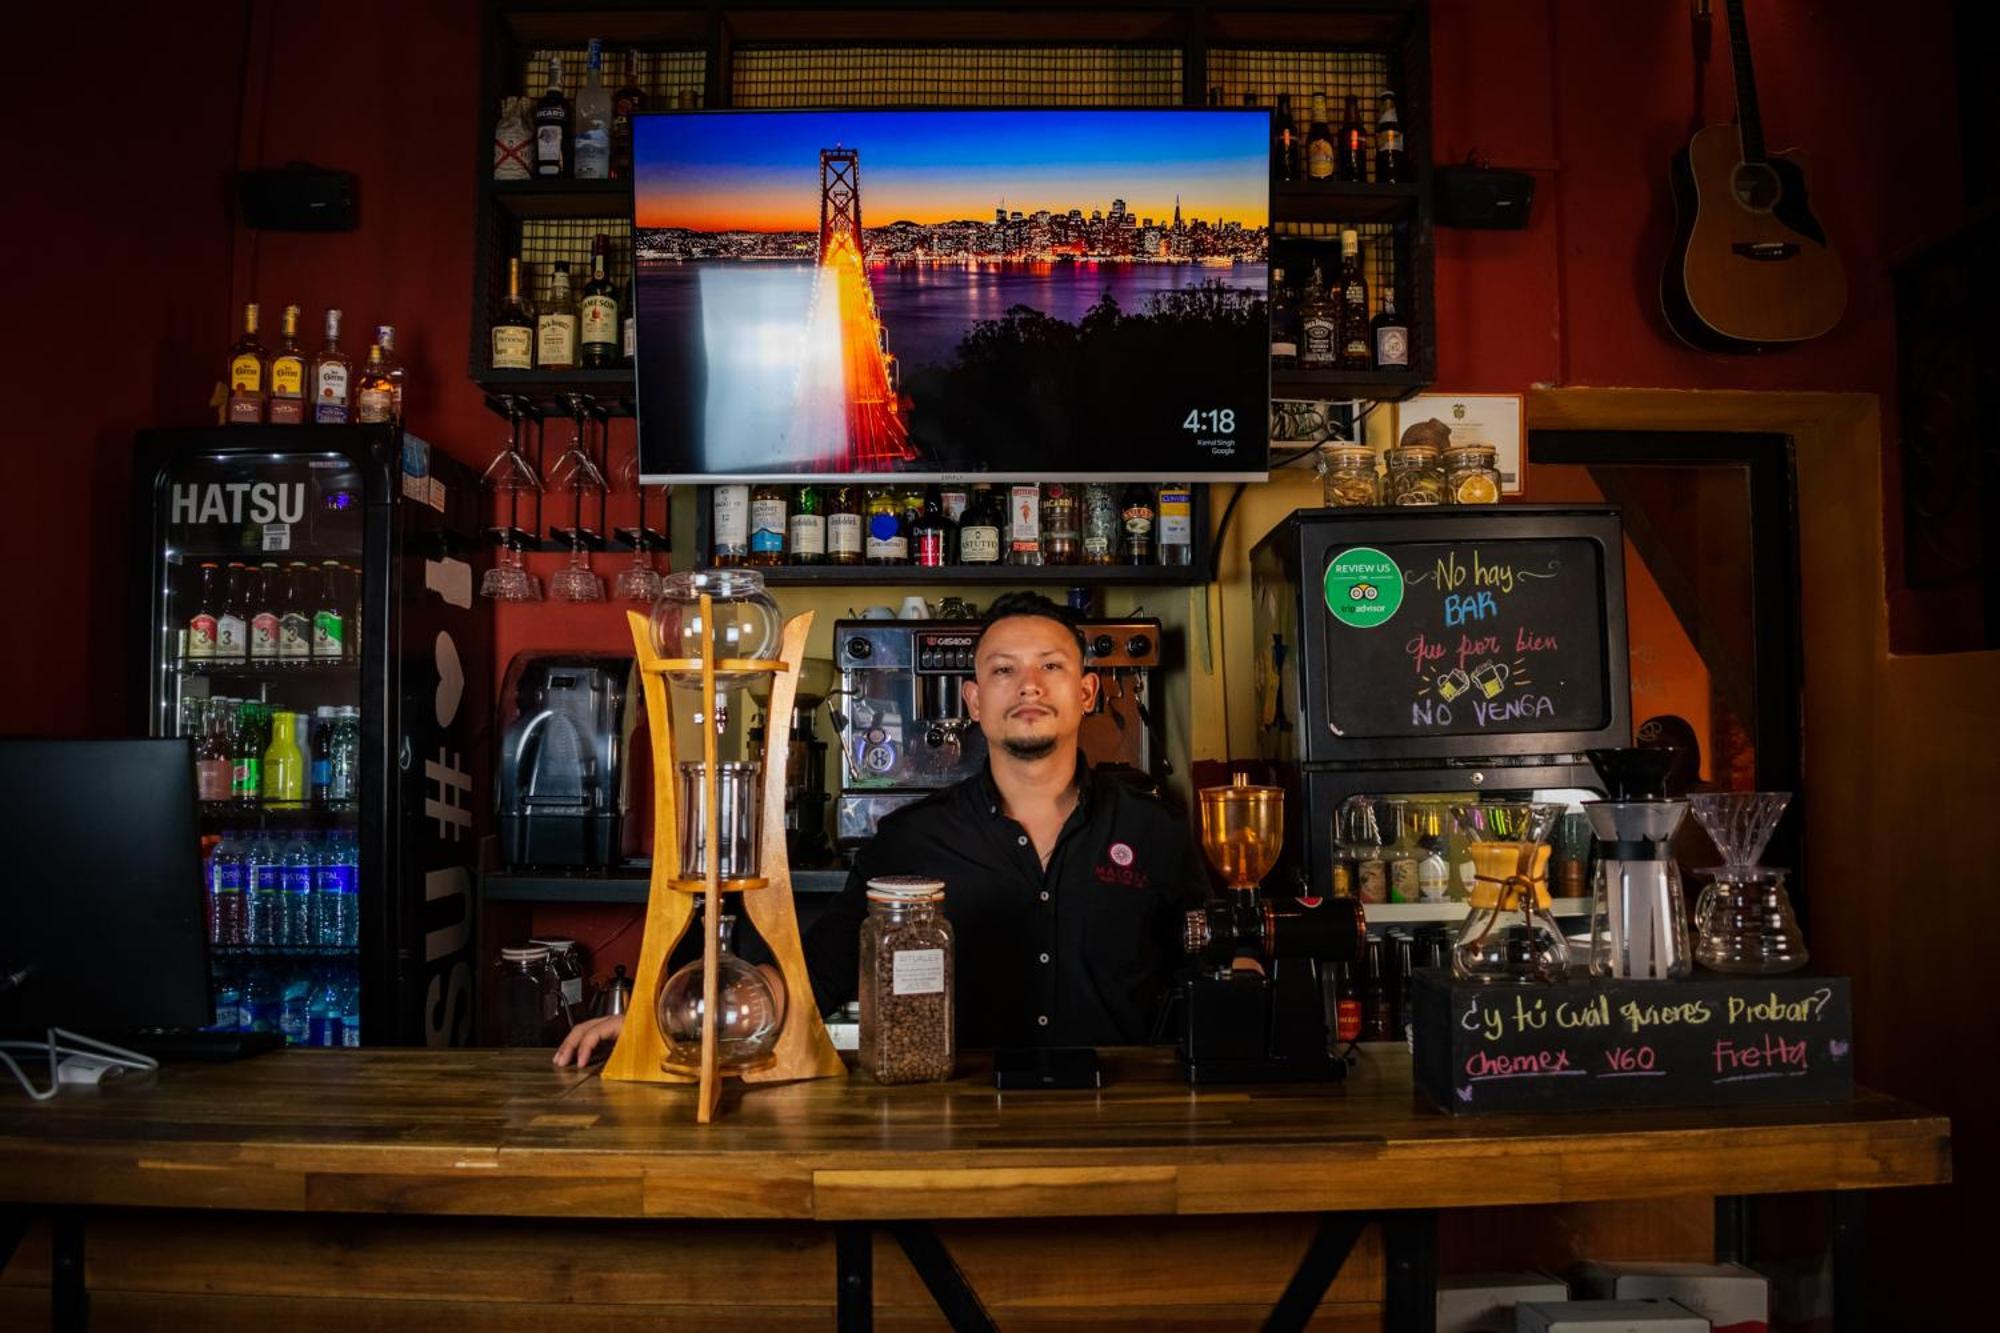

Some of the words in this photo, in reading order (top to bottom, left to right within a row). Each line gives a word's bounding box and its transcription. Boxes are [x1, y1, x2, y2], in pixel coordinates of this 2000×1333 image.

[1182, 408, 1236, 434] 4:18
[1211, 447, 1235, 456] Google
[170, 482, 306, 525] HATSU
[1335, 564, 1375, 574] REVIEW
[1376, 563, 1391, 574] US
[1436, 550, 1467, 592] No
[1473, 549, 1514, 594] hay
[1341, 603, 1385, 613] tripadvisor
[1444, 590, 1498, 628] BAR
[1456, 633, 1501, 670] por
[1515, 625, 1559, 653] bien
[1412, 698, 1453, 726] NO
[1472, 694, 1555, 728] VENGA
[1606, 1046, 1656, 1071] V60
[1711, 1032, 1808, 1075] Fretta
